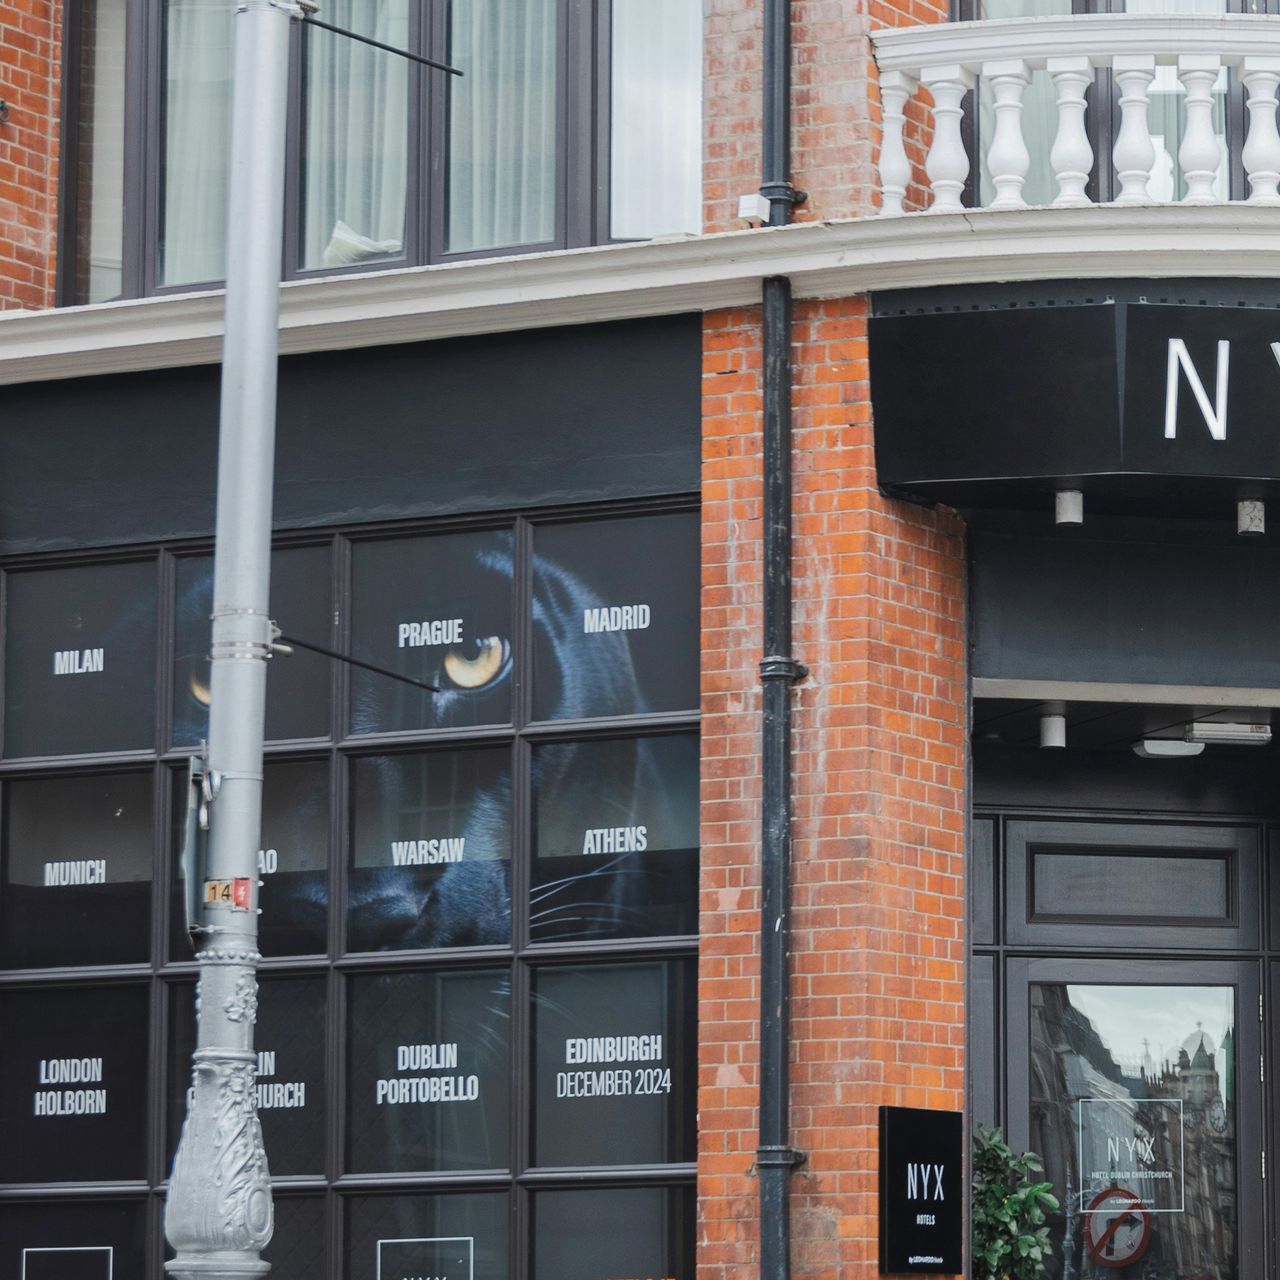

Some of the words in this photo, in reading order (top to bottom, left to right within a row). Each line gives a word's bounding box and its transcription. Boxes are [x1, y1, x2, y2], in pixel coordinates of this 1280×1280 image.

[398, 618, 464, 648] PRAGUE
[583, 604, 651, 634] MADRID
[53, 647, 104, 675] MILAN
[391, 837, 465, 866] WARSAW
[582, 825, 647, 855] ATHENS
[44, 859, 106, 887] MUNICH
[397, 1042, 458, 1071] DUBLIN
[565, 1034, 663, 1064] EDINBURGH
[39, 1057, 103, 1084] LONDON
[556, 1069, 633, 1098] DECEMBER
[634, 1067, 672, 1095] 2024
[34, 1089, 107, 1116] HOLBORN
[376, 1074, 480, 1105] PORTOBELLO
[1107, 1137, 1155, 1162] NYX
[907, 1163, 944, 1201] NYX
[1091, 1170, 1109, 1179] HOTEL
[1110, 1170, 1130, 1179] DUBLIN
[1131, 1170, 1173, 1179] CHRISTCHURCH
[916, 1214, 935, 1225] HOTELS
